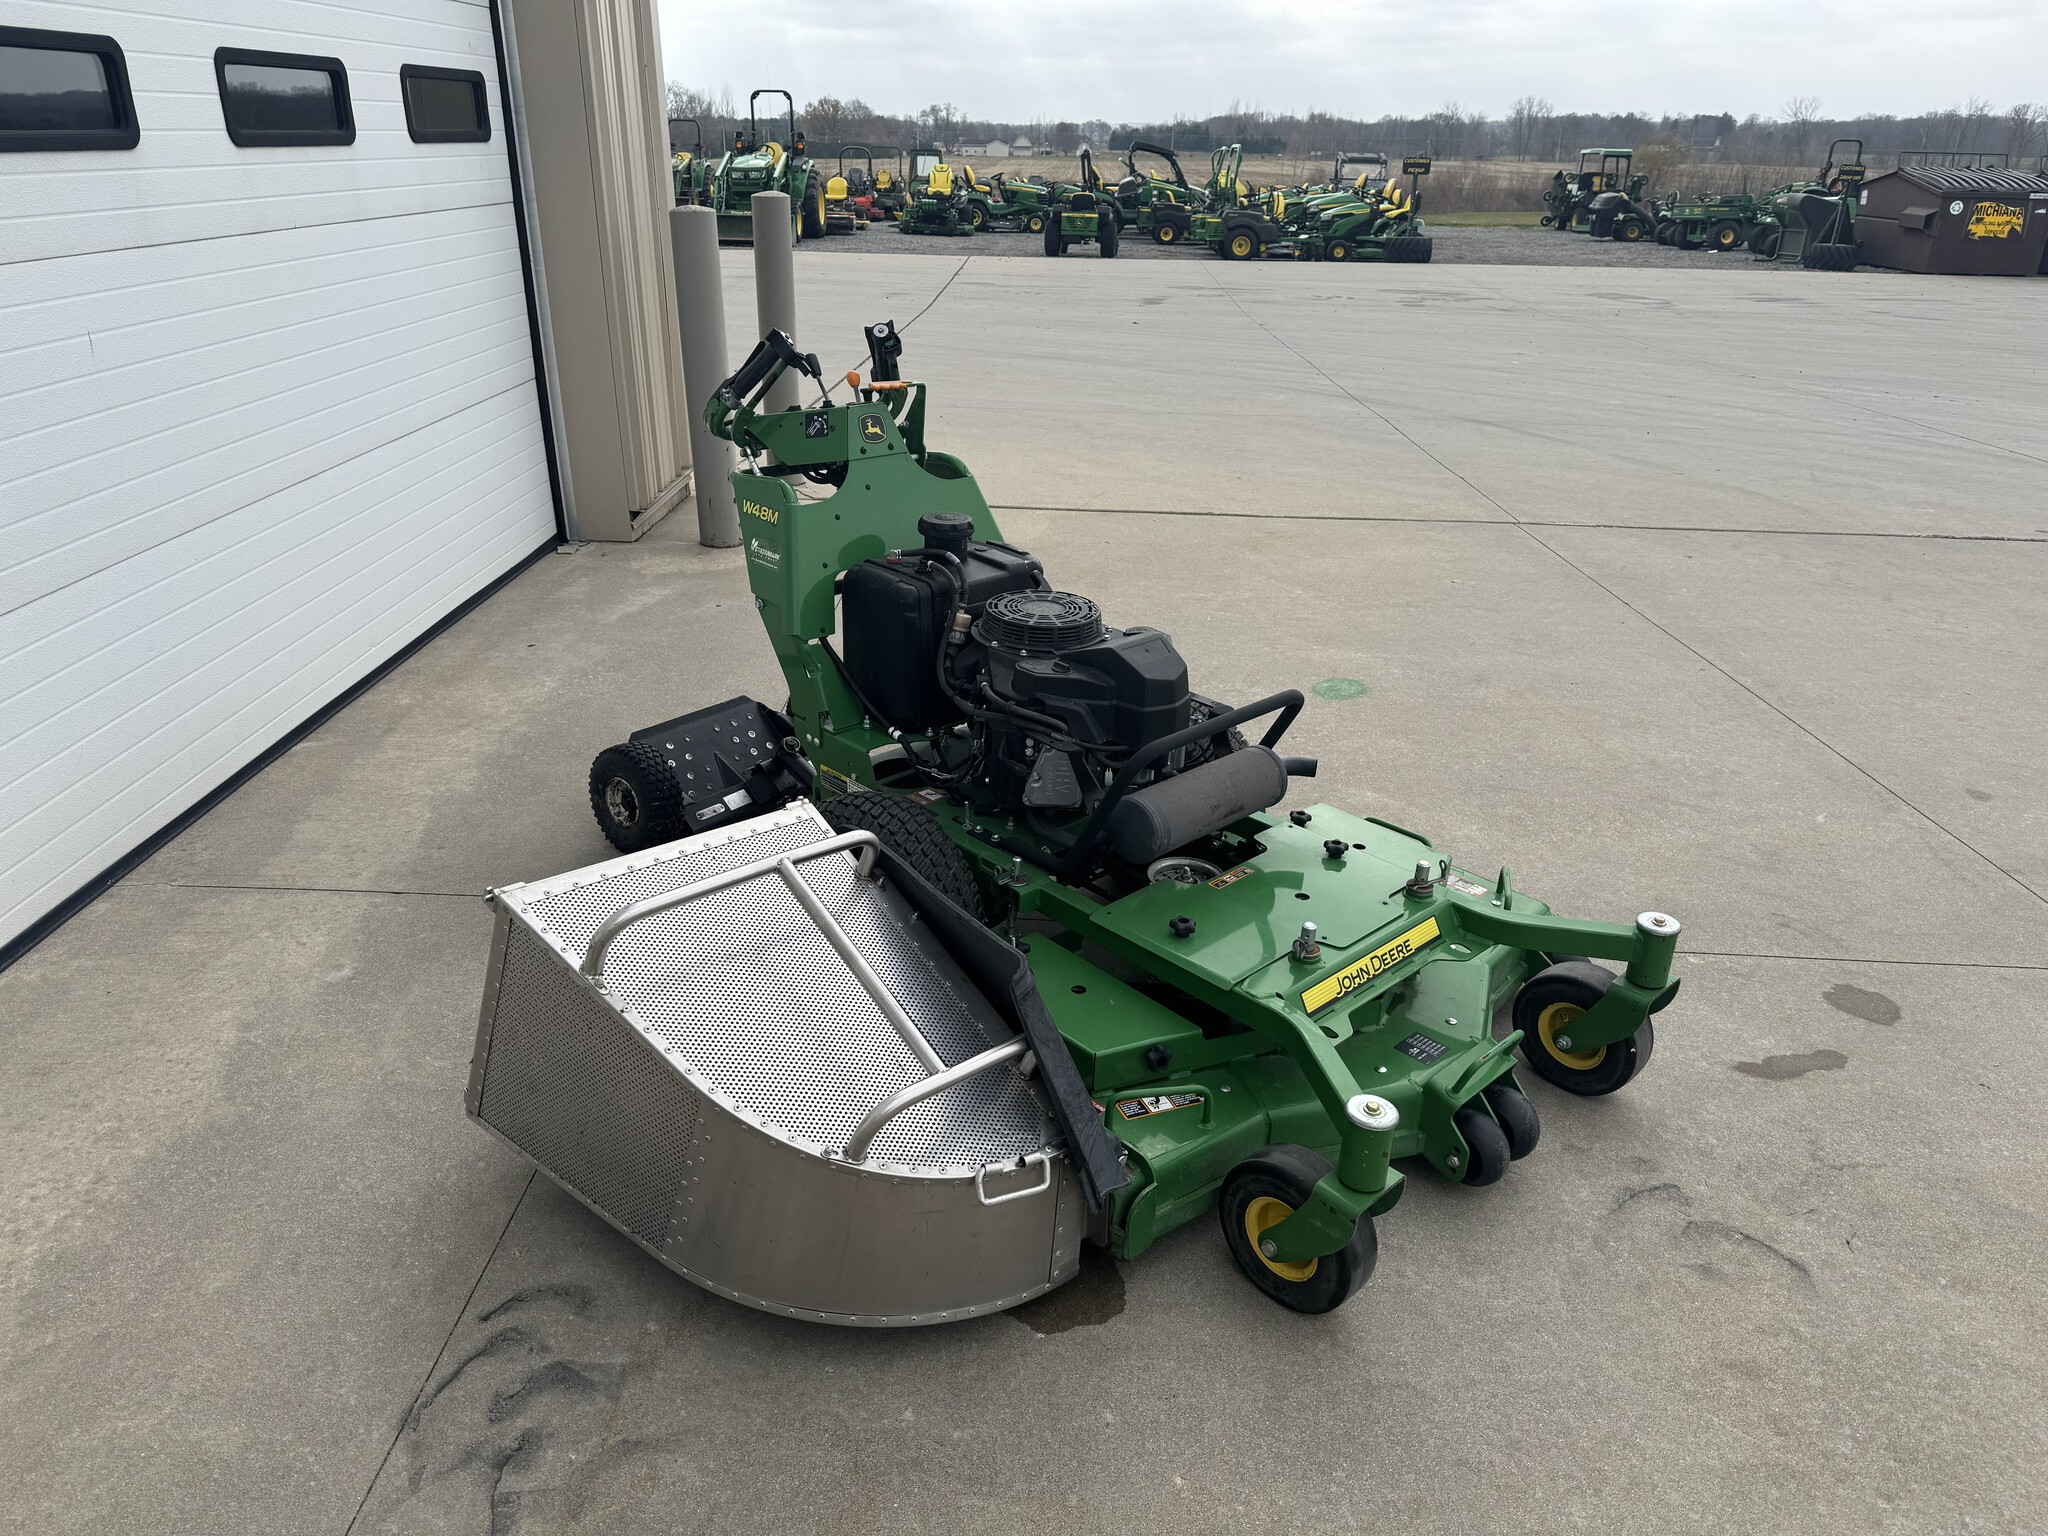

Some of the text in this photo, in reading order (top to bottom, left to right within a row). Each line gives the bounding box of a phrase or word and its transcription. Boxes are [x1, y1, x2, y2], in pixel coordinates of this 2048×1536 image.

[1975, 205, 2023, 217] MICHIANA
[743, 499, 778, 525] W48M
[1336, 938, 1413, 996] JOHN DEERE
